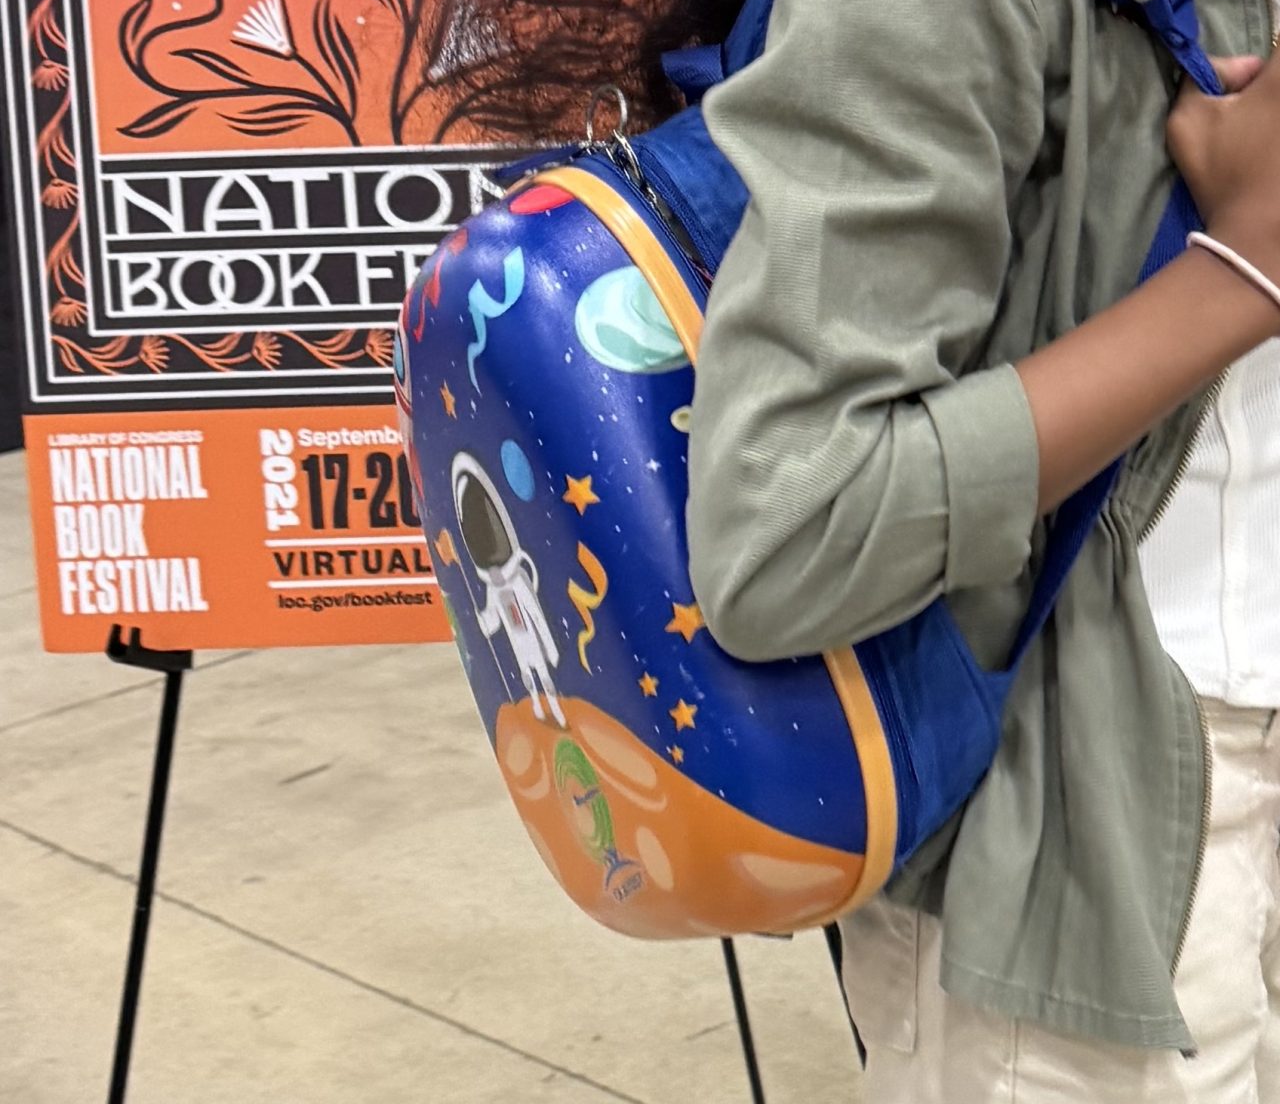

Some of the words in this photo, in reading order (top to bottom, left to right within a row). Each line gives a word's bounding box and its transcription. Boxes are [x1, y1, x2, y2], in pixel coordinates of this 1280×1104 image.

[113, 166, 506, 237] NATIO
[120, 249, 331, 314] BOOK
[298, 426, 403, 449] Septemb
[49, 445, 208, 502] NATIONAL
[259, 429, 300, 531] 2021
[54, 503, 149, 559] BOOK
[58, 557, 209, 615] FESTIVAL
[274, 548, 432, 577] VIRTUAL
[278, 591, 434, 613] loc.gov/bookfest
